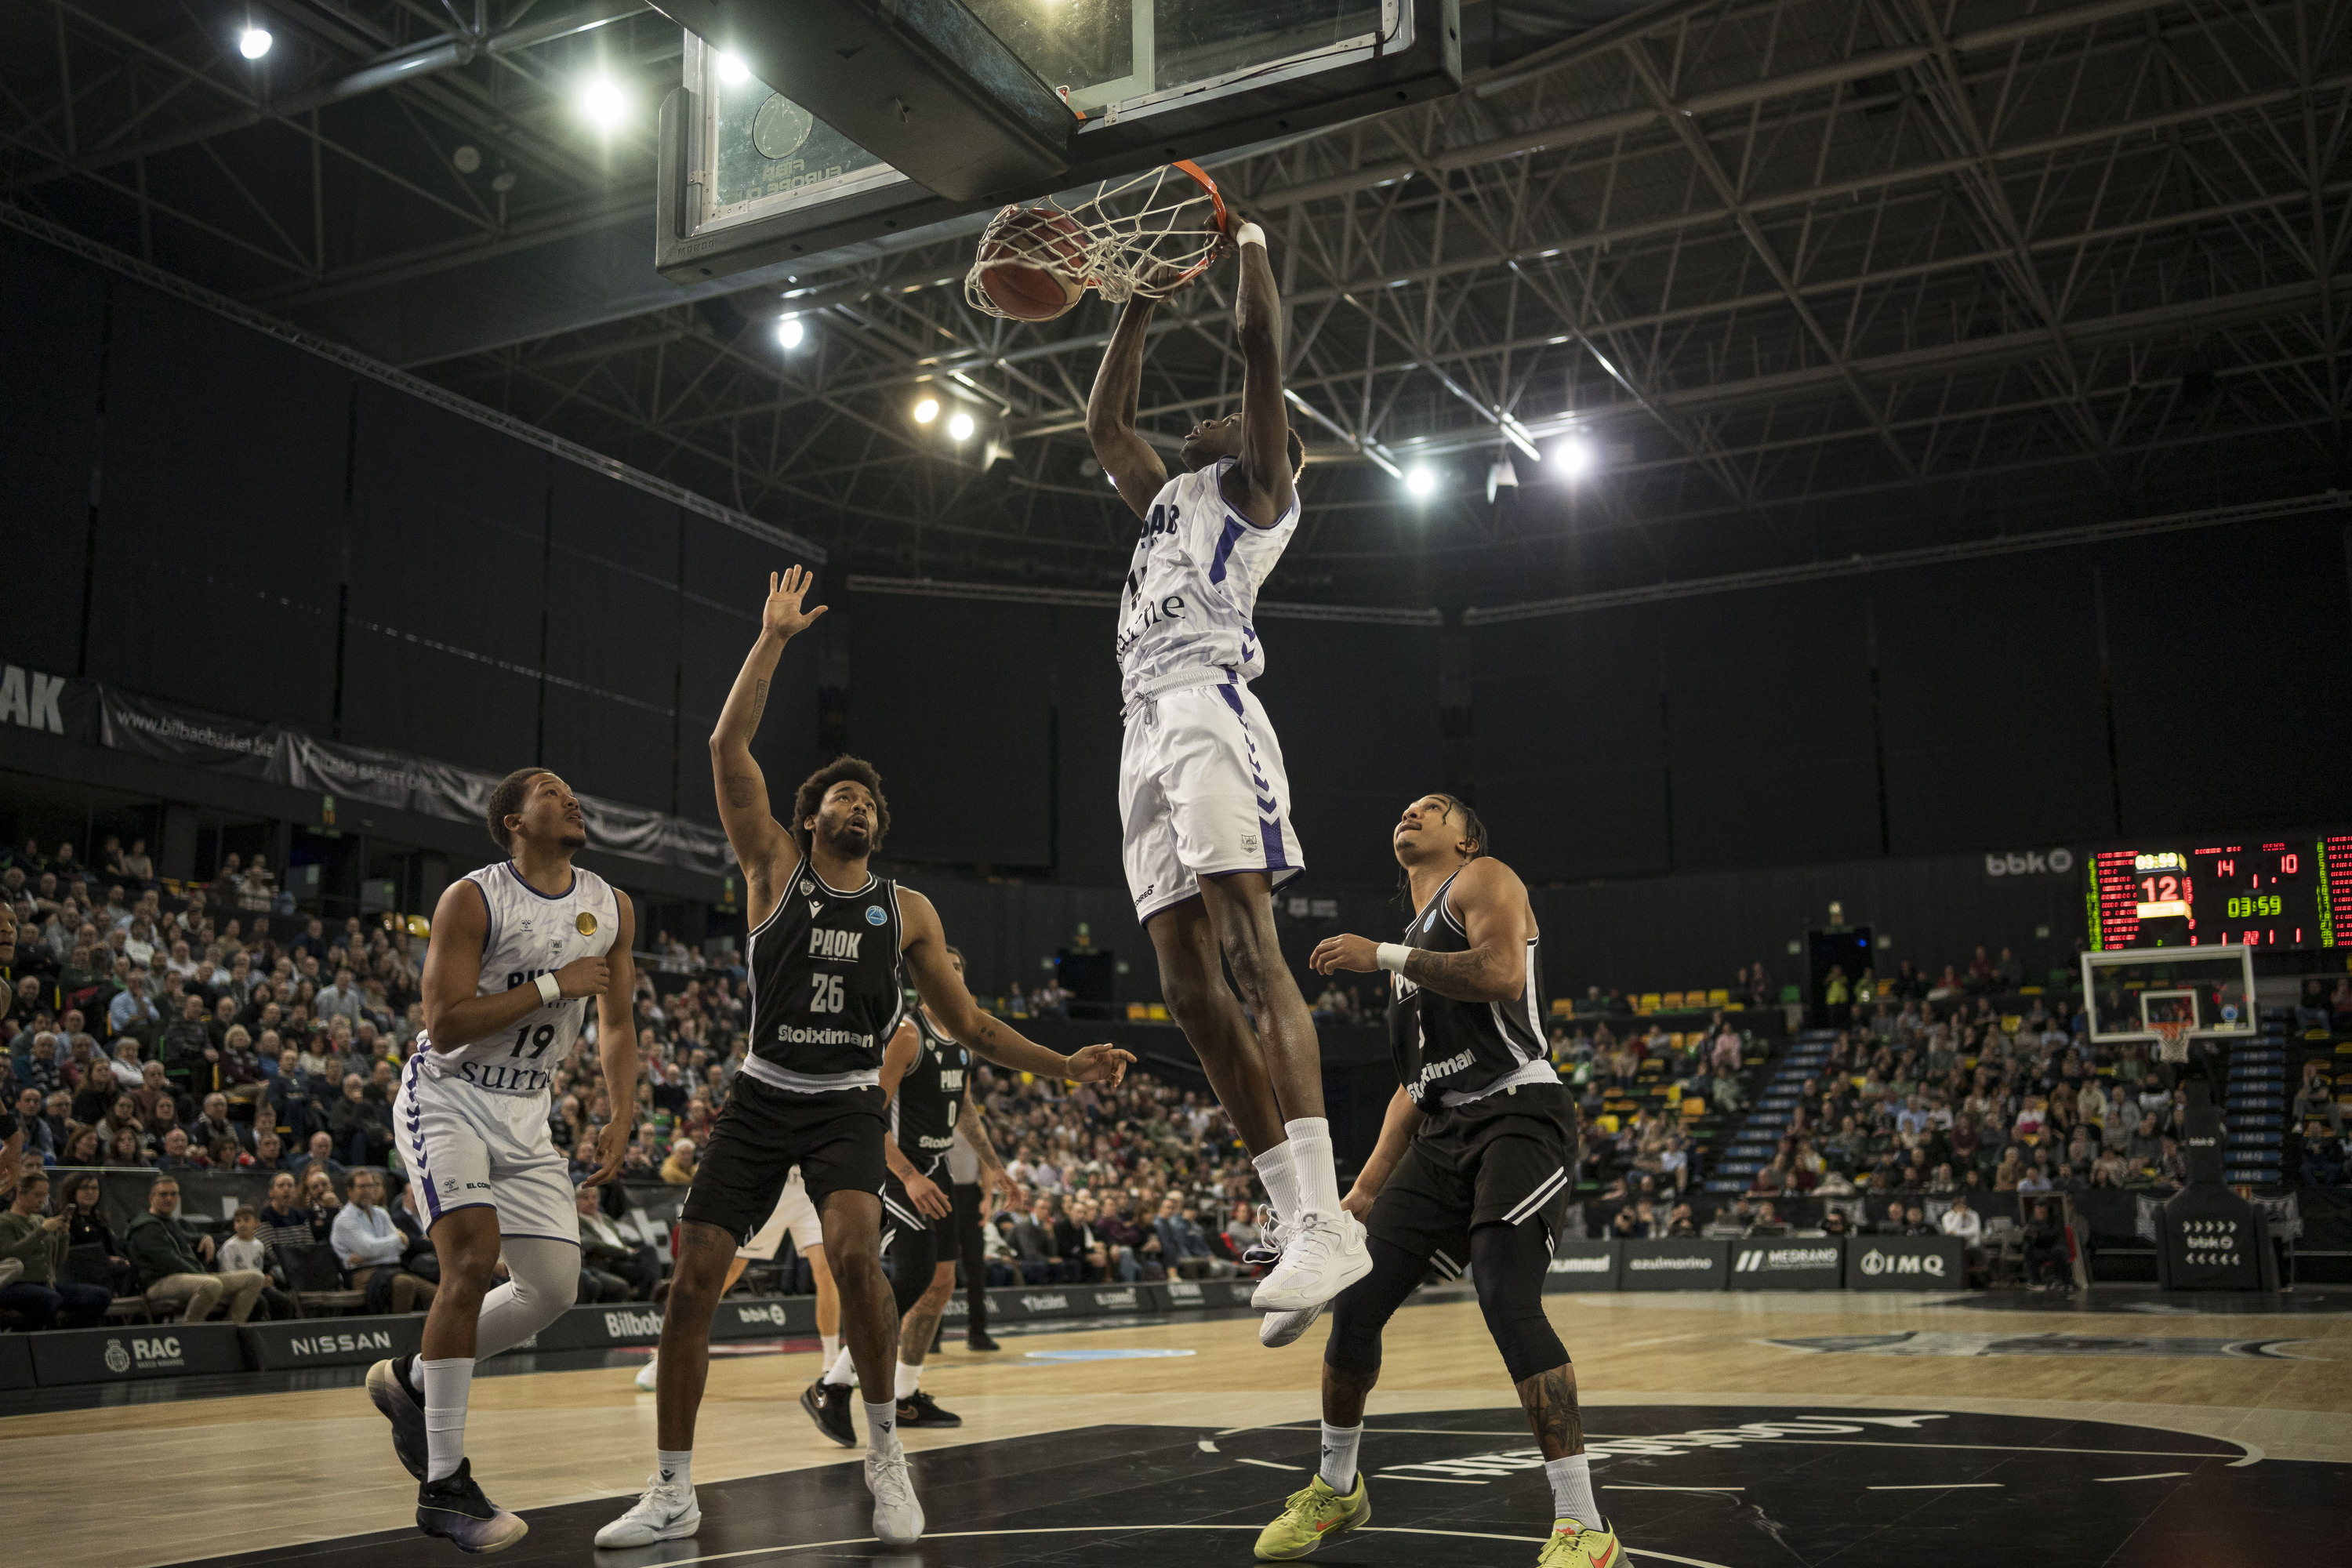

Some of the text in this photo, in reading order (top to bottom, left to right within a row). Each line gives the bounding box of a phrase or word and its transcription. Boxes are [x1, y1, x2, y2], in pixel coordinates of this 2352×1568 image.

[2217, 854, 2298, 877] 14 10
[1134, 889, 1153, 908] ORREO
[2141, 876, 2179, 902] 12
[2227, 895, 2281, 917] 03:59
[809, 927, 863, 960] PAOK
[810, 973, 844, 1014] 26
[510, 1024, 555, 1058] 19
[778, 1024, 874, 1048] Stoiximan
[1767, 1247, 1838, 1264] MEDRANO
[1884, 1255, 1946, 1278] IMQ
[132, 1336, 182, 1360] RAC
[291, 1331, 392, 1356] NISSAN
